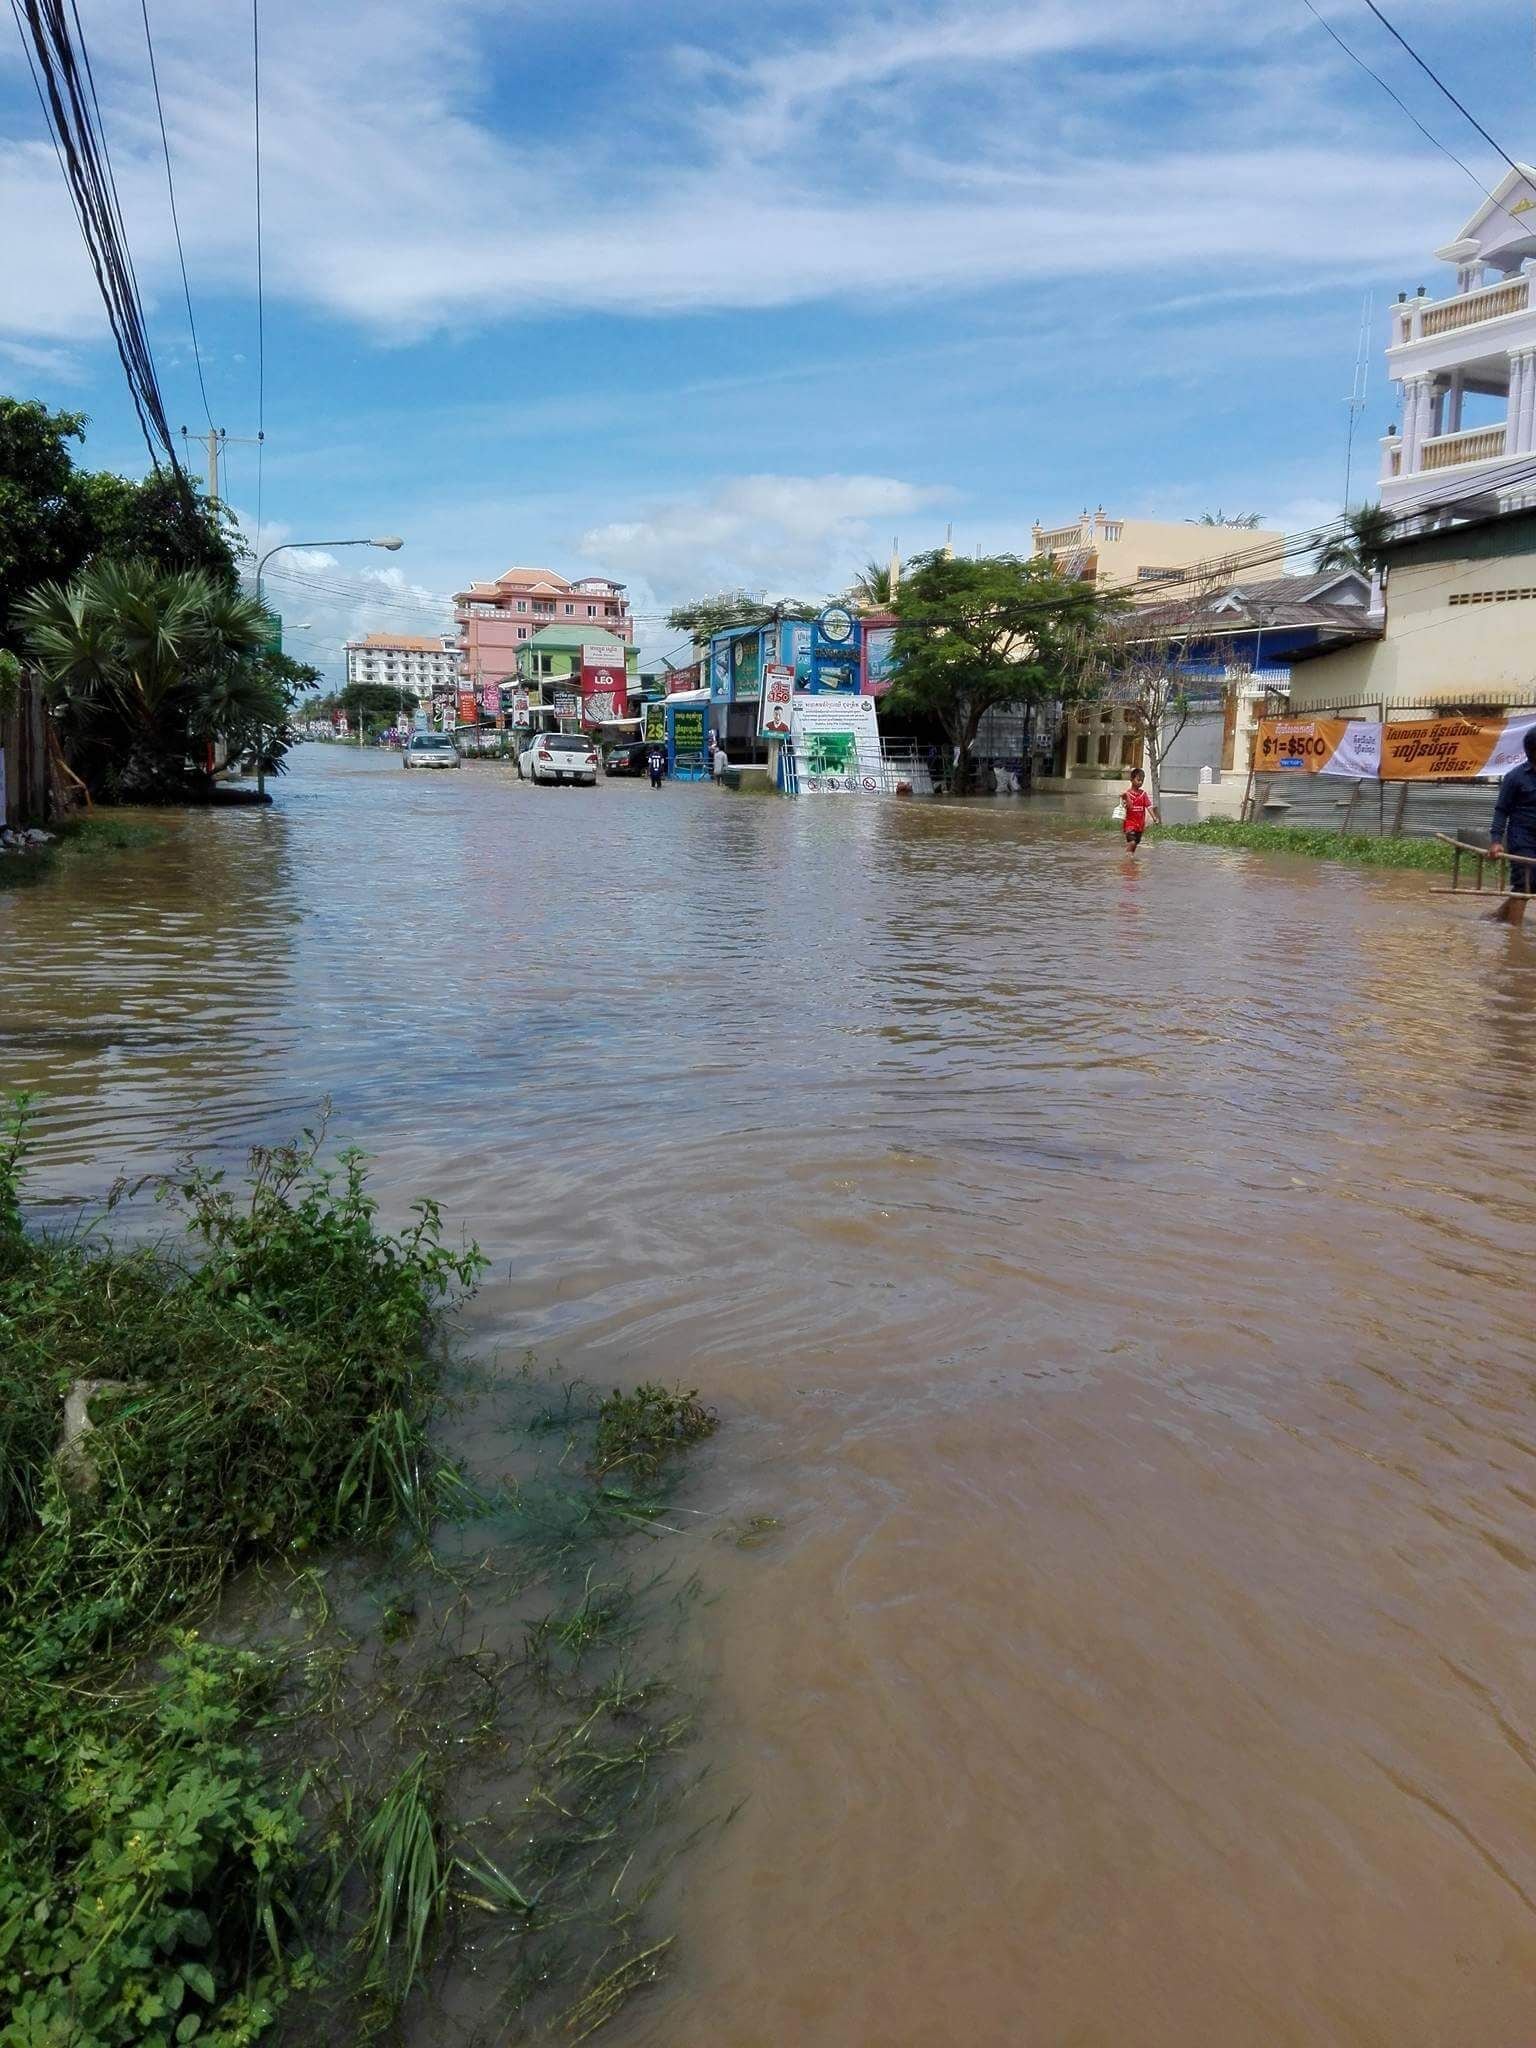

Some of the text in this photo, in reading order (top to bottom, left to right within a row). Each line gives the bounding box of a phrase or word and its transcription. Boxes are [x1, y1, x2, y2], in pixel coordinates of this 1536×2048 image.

[594, 676, 614, 685] LEO
[770, 692, 790, 703] 150
[1263, 736, 1326, 757] $1=$500
